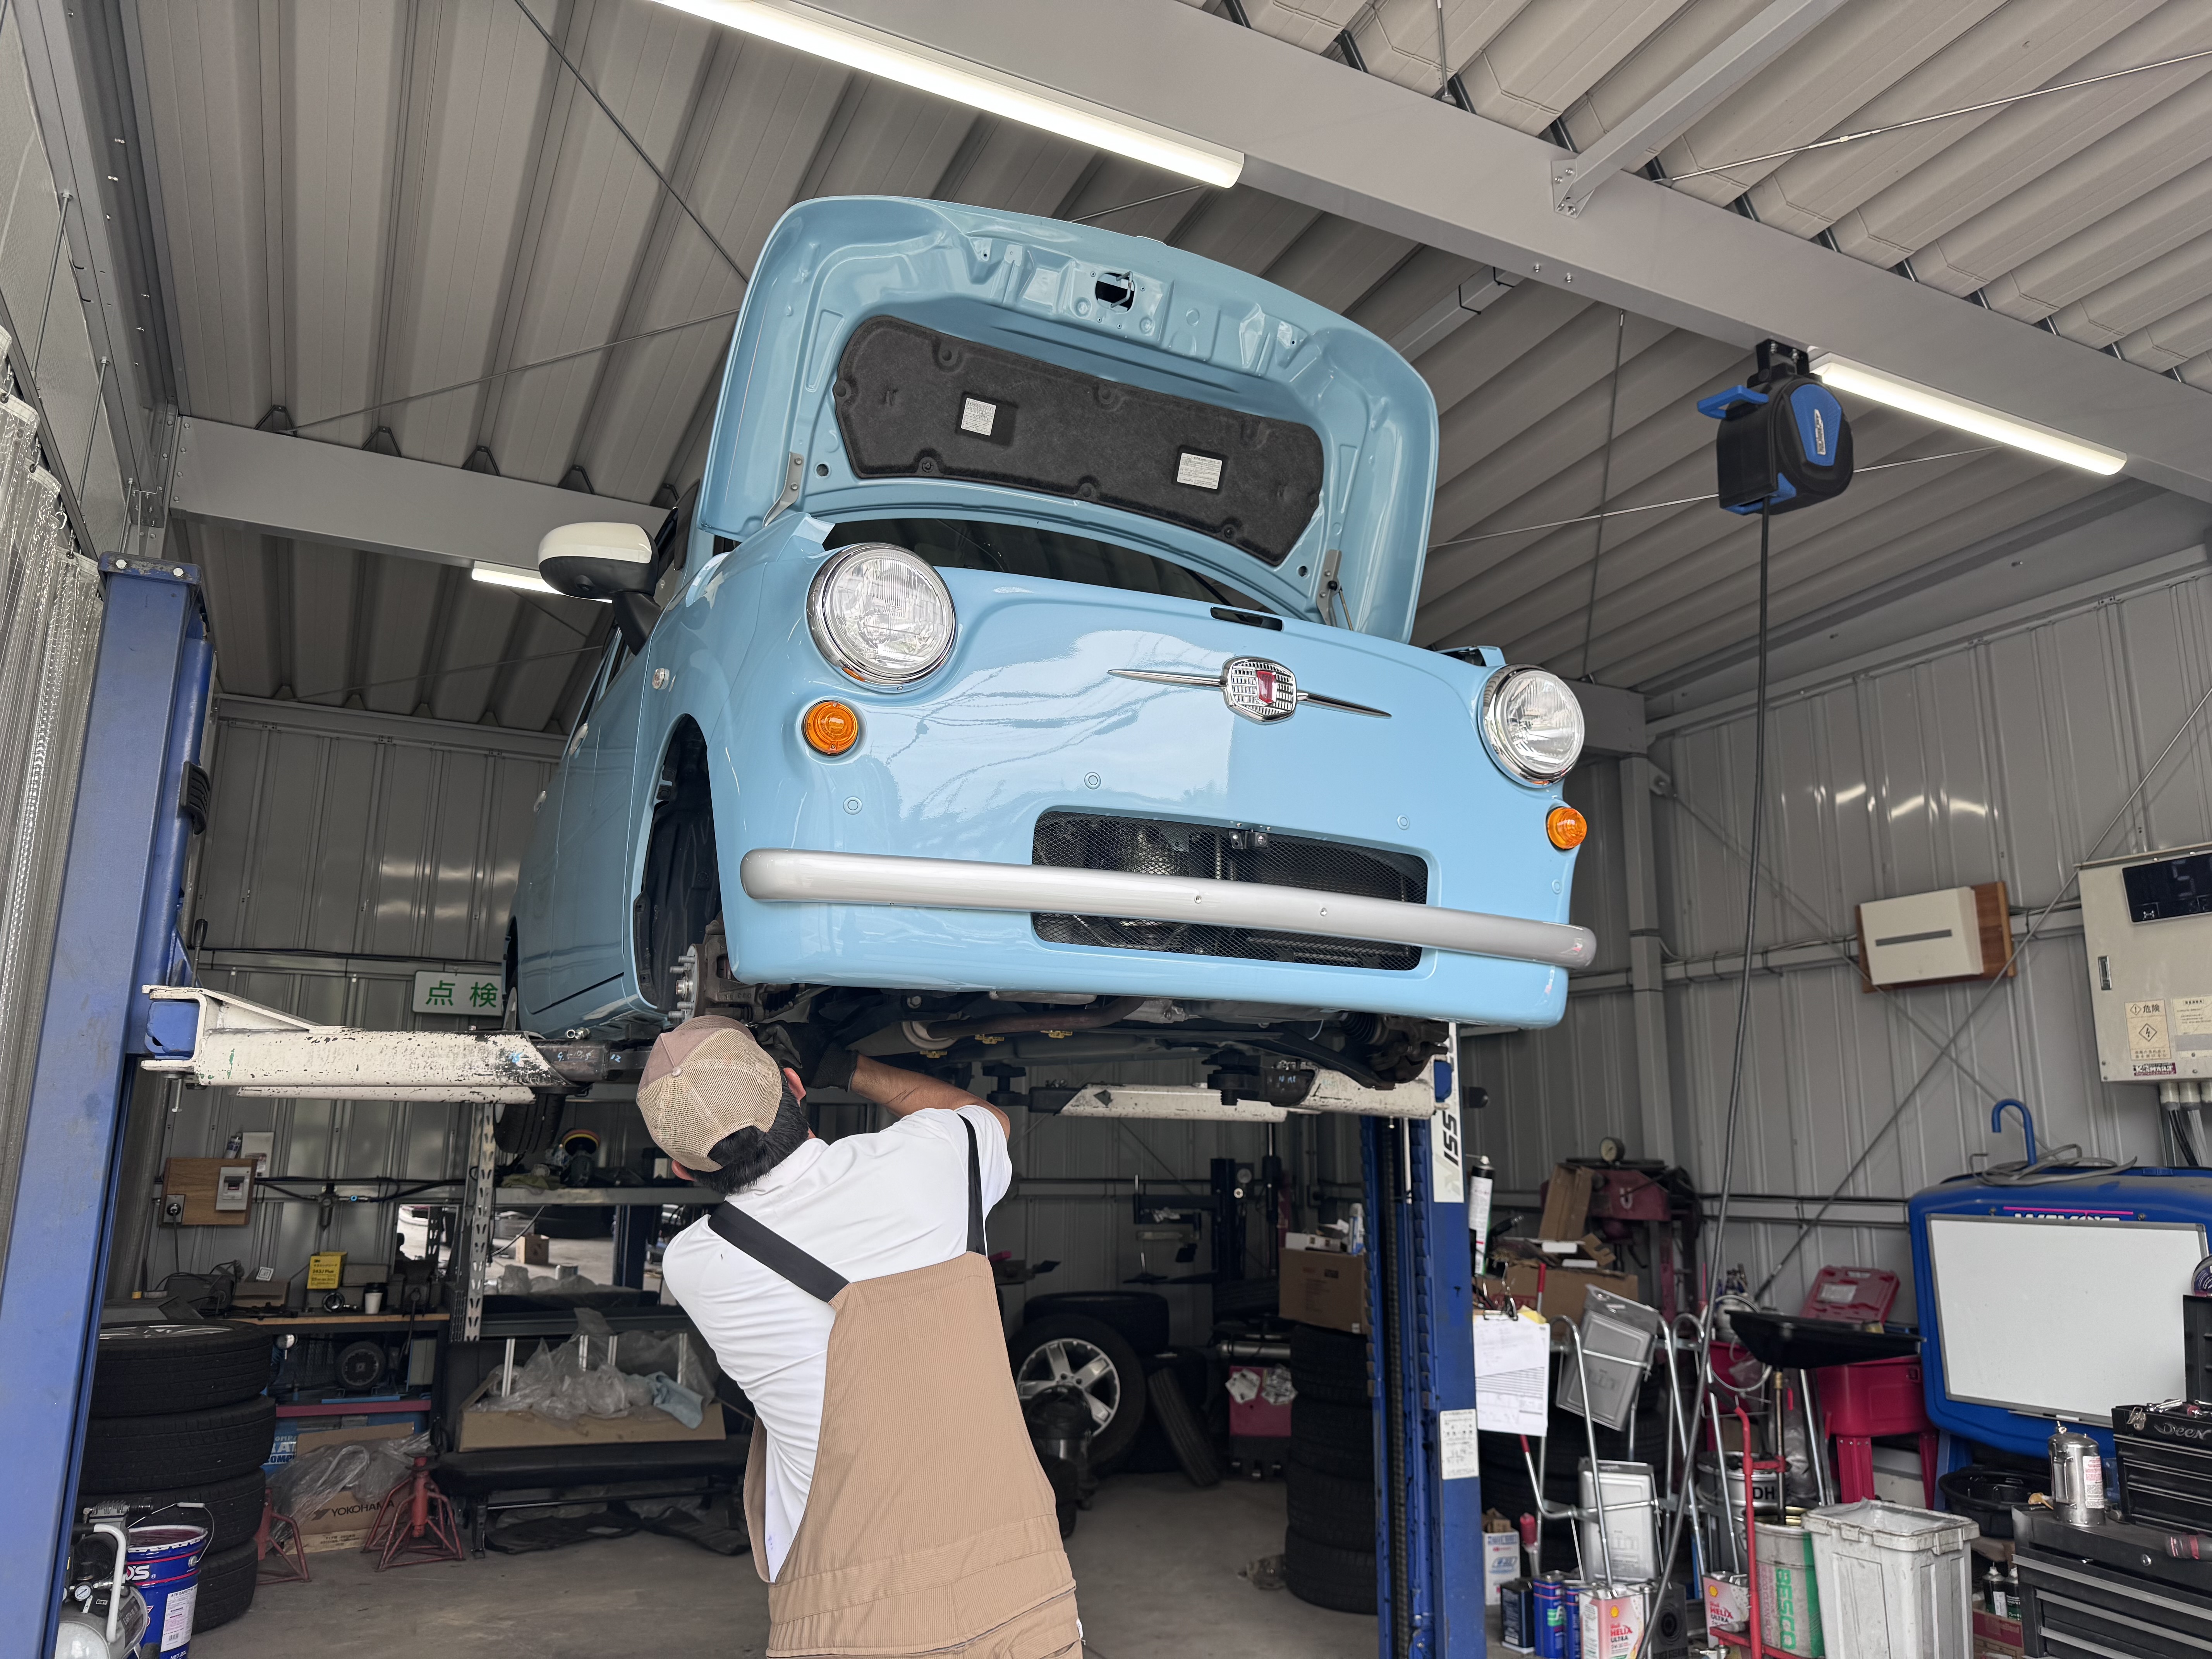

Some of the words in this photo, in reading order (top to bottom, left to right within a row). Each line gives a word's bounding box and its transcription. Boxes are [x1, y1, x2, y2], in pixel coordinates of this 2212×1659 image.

[426, 980, 498, 1007] 点検
[2143, 1004, 2160, 1013] 危険
[1775, 1568, 1796, 1650] BESCO
